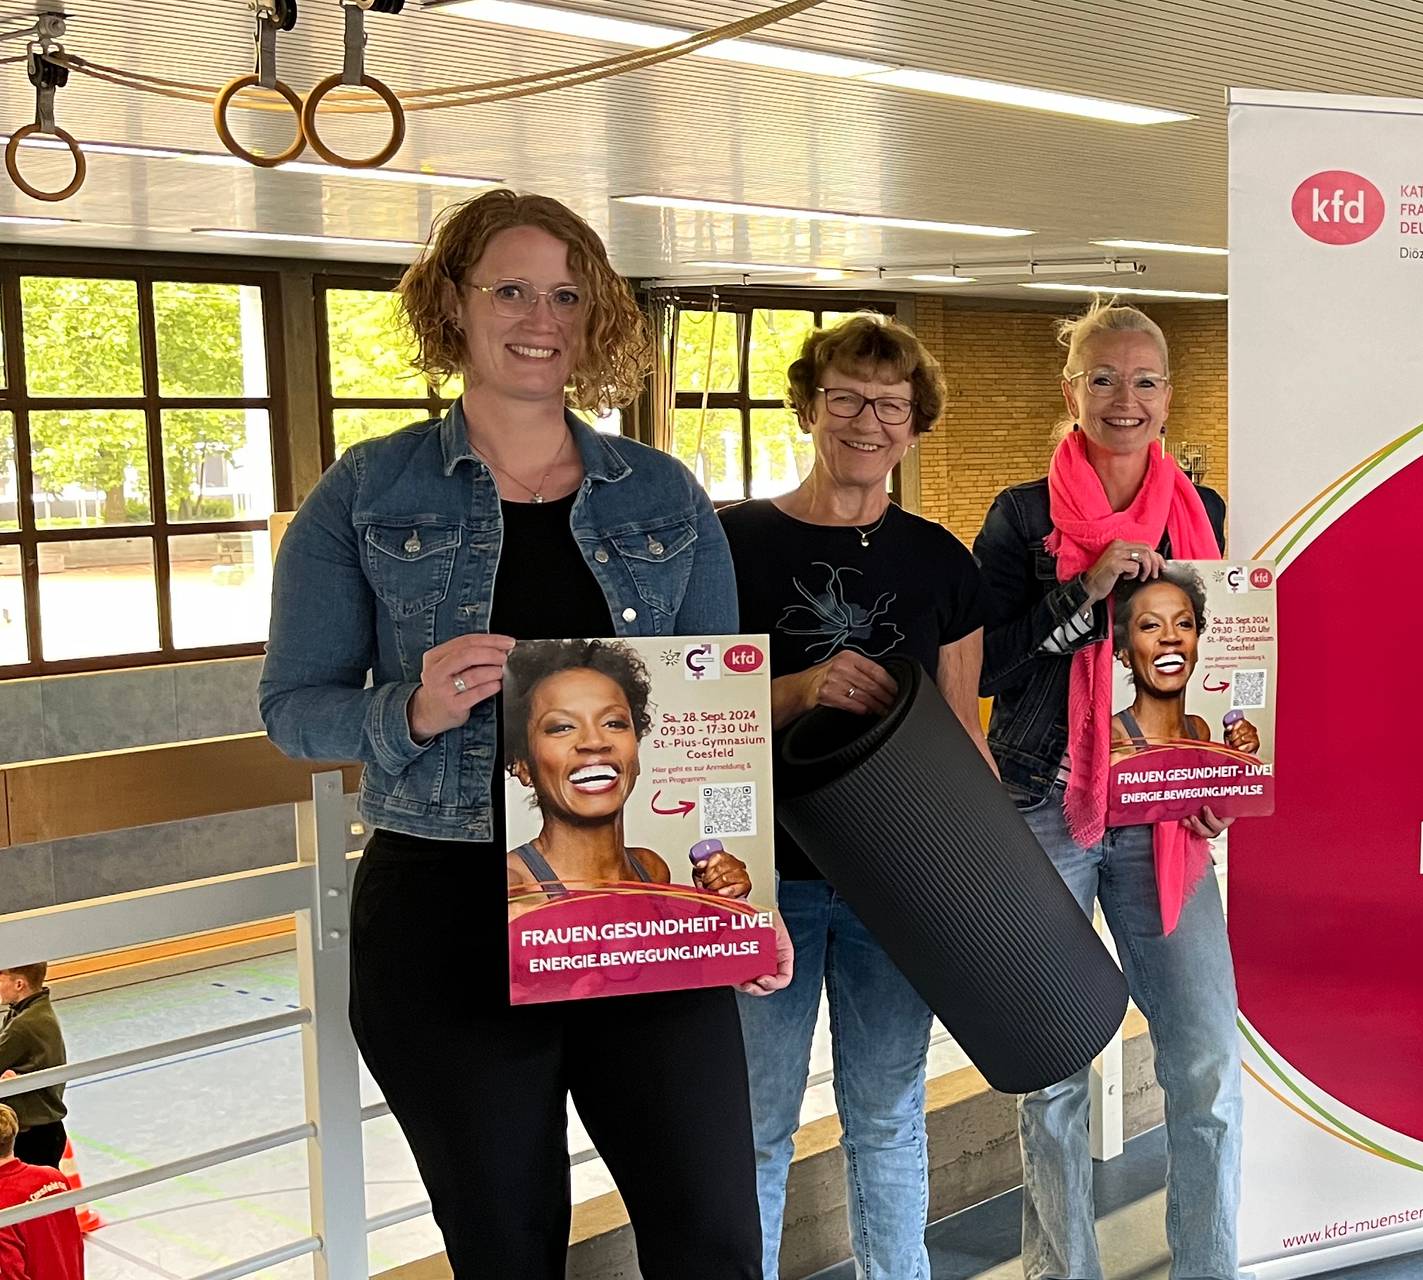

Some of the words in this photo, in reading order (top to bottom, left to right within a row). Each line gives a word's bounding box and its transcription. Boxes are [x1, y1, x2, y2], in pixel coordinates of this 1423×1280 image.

[1312, 188, 1365, 224] kfd
[1254, 572, 1268, 583] kfd
[732, 651, 755, 665] kfd
[700, 711, 727, 724] Sept.
[729, 710, 756, 720] 2024
[661, 725, 695, 736] 09:30
[707, 724, 735, 734] 17:30
[739, 723, 759, 733] Uhr
[653, 736, 765, 749] St.-Pius-Gymnasium
[687, 748, 734, 759] Coesfeld
[1117, 766, 1243, 785] FRAUEN.GESUNDHEIT-
[1245, 764, 1273, 776] LIVE!
[1121, 785, 1264, 804] ENERGIE.BEWEGUNG.IMPULSE
[521, 916, 727, 947] FRAUEN.GESUNDHEIT-
[730, 912, 774, 930] LIVE!
[529, 941, 760, 973] ENERGIE.BEWEGUNG.IMPULSE
